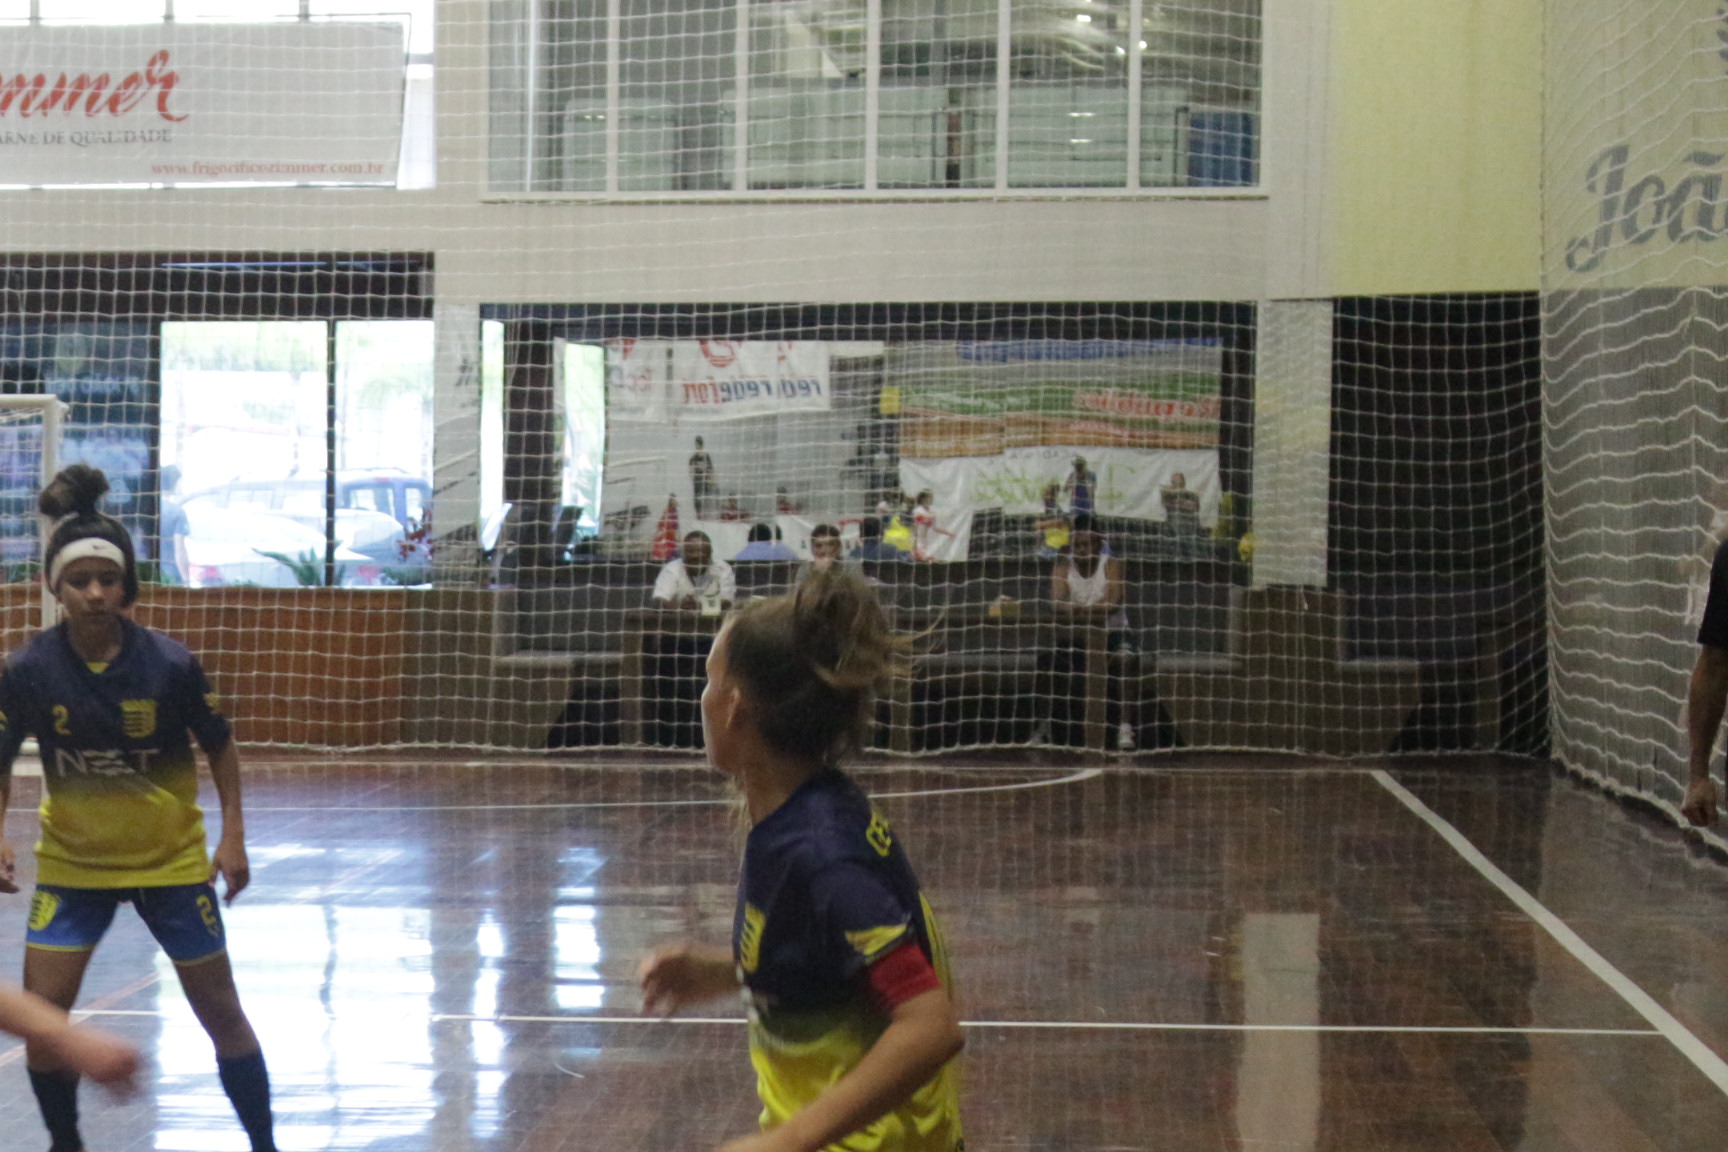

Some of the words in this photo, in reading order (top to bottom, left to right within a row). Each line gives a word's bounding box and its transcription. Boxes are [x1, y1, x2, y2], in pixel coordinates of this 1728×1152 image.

[42, 131, 66, 145] DE
[69, 129, 173, 147] QUALIDADE
[1565, 144, 1728, 273] Joã
[51, 704, 71, 735] 2
